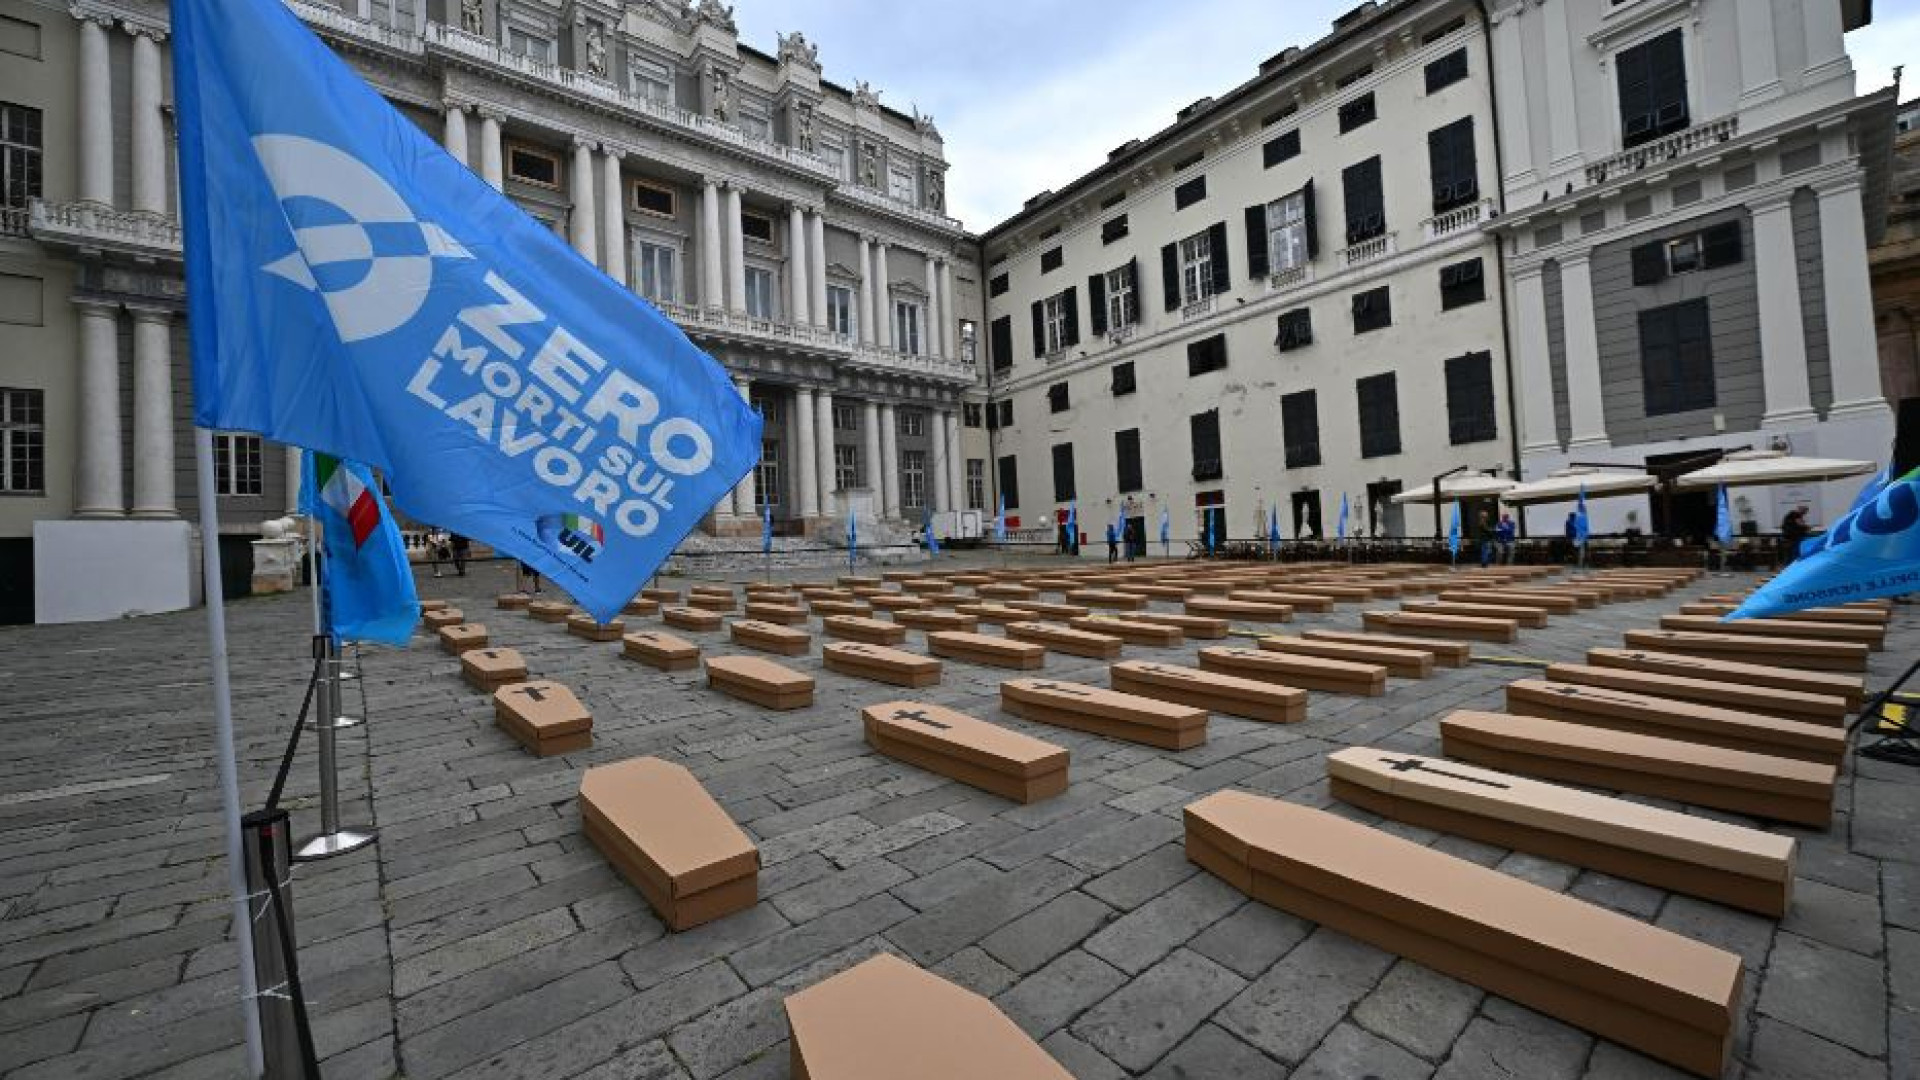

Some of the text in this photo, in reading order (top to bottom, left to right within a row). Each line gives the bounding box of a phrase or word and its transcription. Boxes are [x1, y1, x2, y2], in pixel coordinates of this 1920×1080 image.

[406, 358, 660, 537] LAVORO
[432, 325, 674, 511] MORTI SUL
[457, 269, 713, 476] ZERO
[558, 527, 595, 563] UIL
